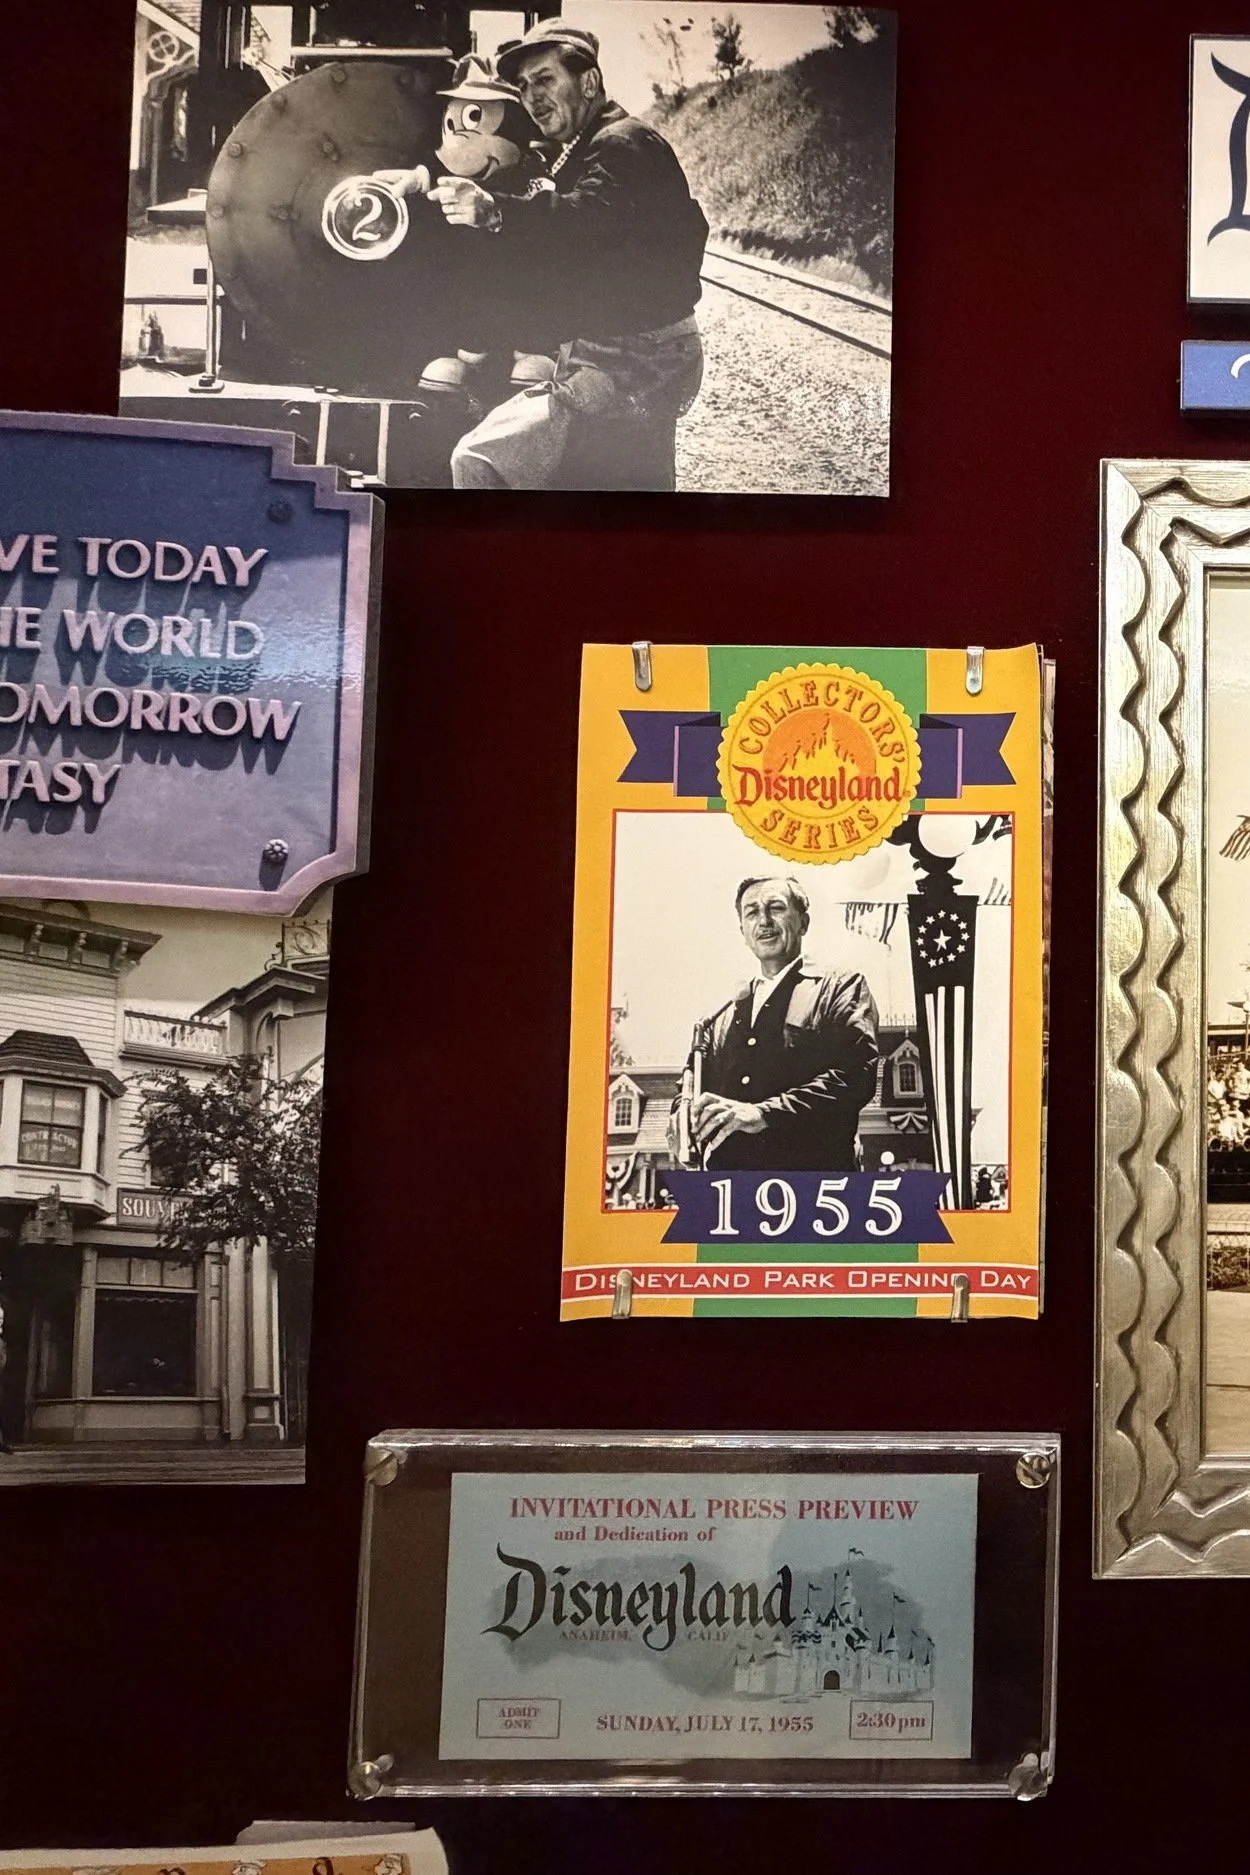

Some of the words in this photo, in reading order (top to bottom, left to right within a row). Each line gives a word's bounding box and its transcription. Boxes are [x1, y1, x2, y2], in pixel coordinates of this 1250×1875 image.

[352, 193, 383, 241] 2
[78, 536, 268, 588] TODAY
[63, 608, 265, 661] WORLD
[738, 679, 906, 764] COLLECTORS'
[731, 763, 902, 810] Disneyland
[759, 805, 880, 850] SERIES
[708, 1175, 903, 1237] 1955
[510, 1497, 697, 1519] INVITATIONAL
[706, 1498, 787, 1519] PRESS
[797, 1499, 919, 1520] PREVIEW
[554, 1526, 587, 1541] and
[594, 1526, 688, 1542] Dedication
[697, 1526, 717, 1541] of
[480, 1542, 797, 1650] Disneyland
[499, 1707, 540, 1719] ADMIT
[504, 1719, 533, 1730] ONE
[596, 1714, 681, 1734] SUNDAY,
[684, 1715, 733, 1732] JULY
[740, 1715, 763, 1734] 17,
[769, 1715, 814, 1733] 1955
[856, 1711, 896, 1729] 2:30
[898, 1716, 926, 1733] pm
